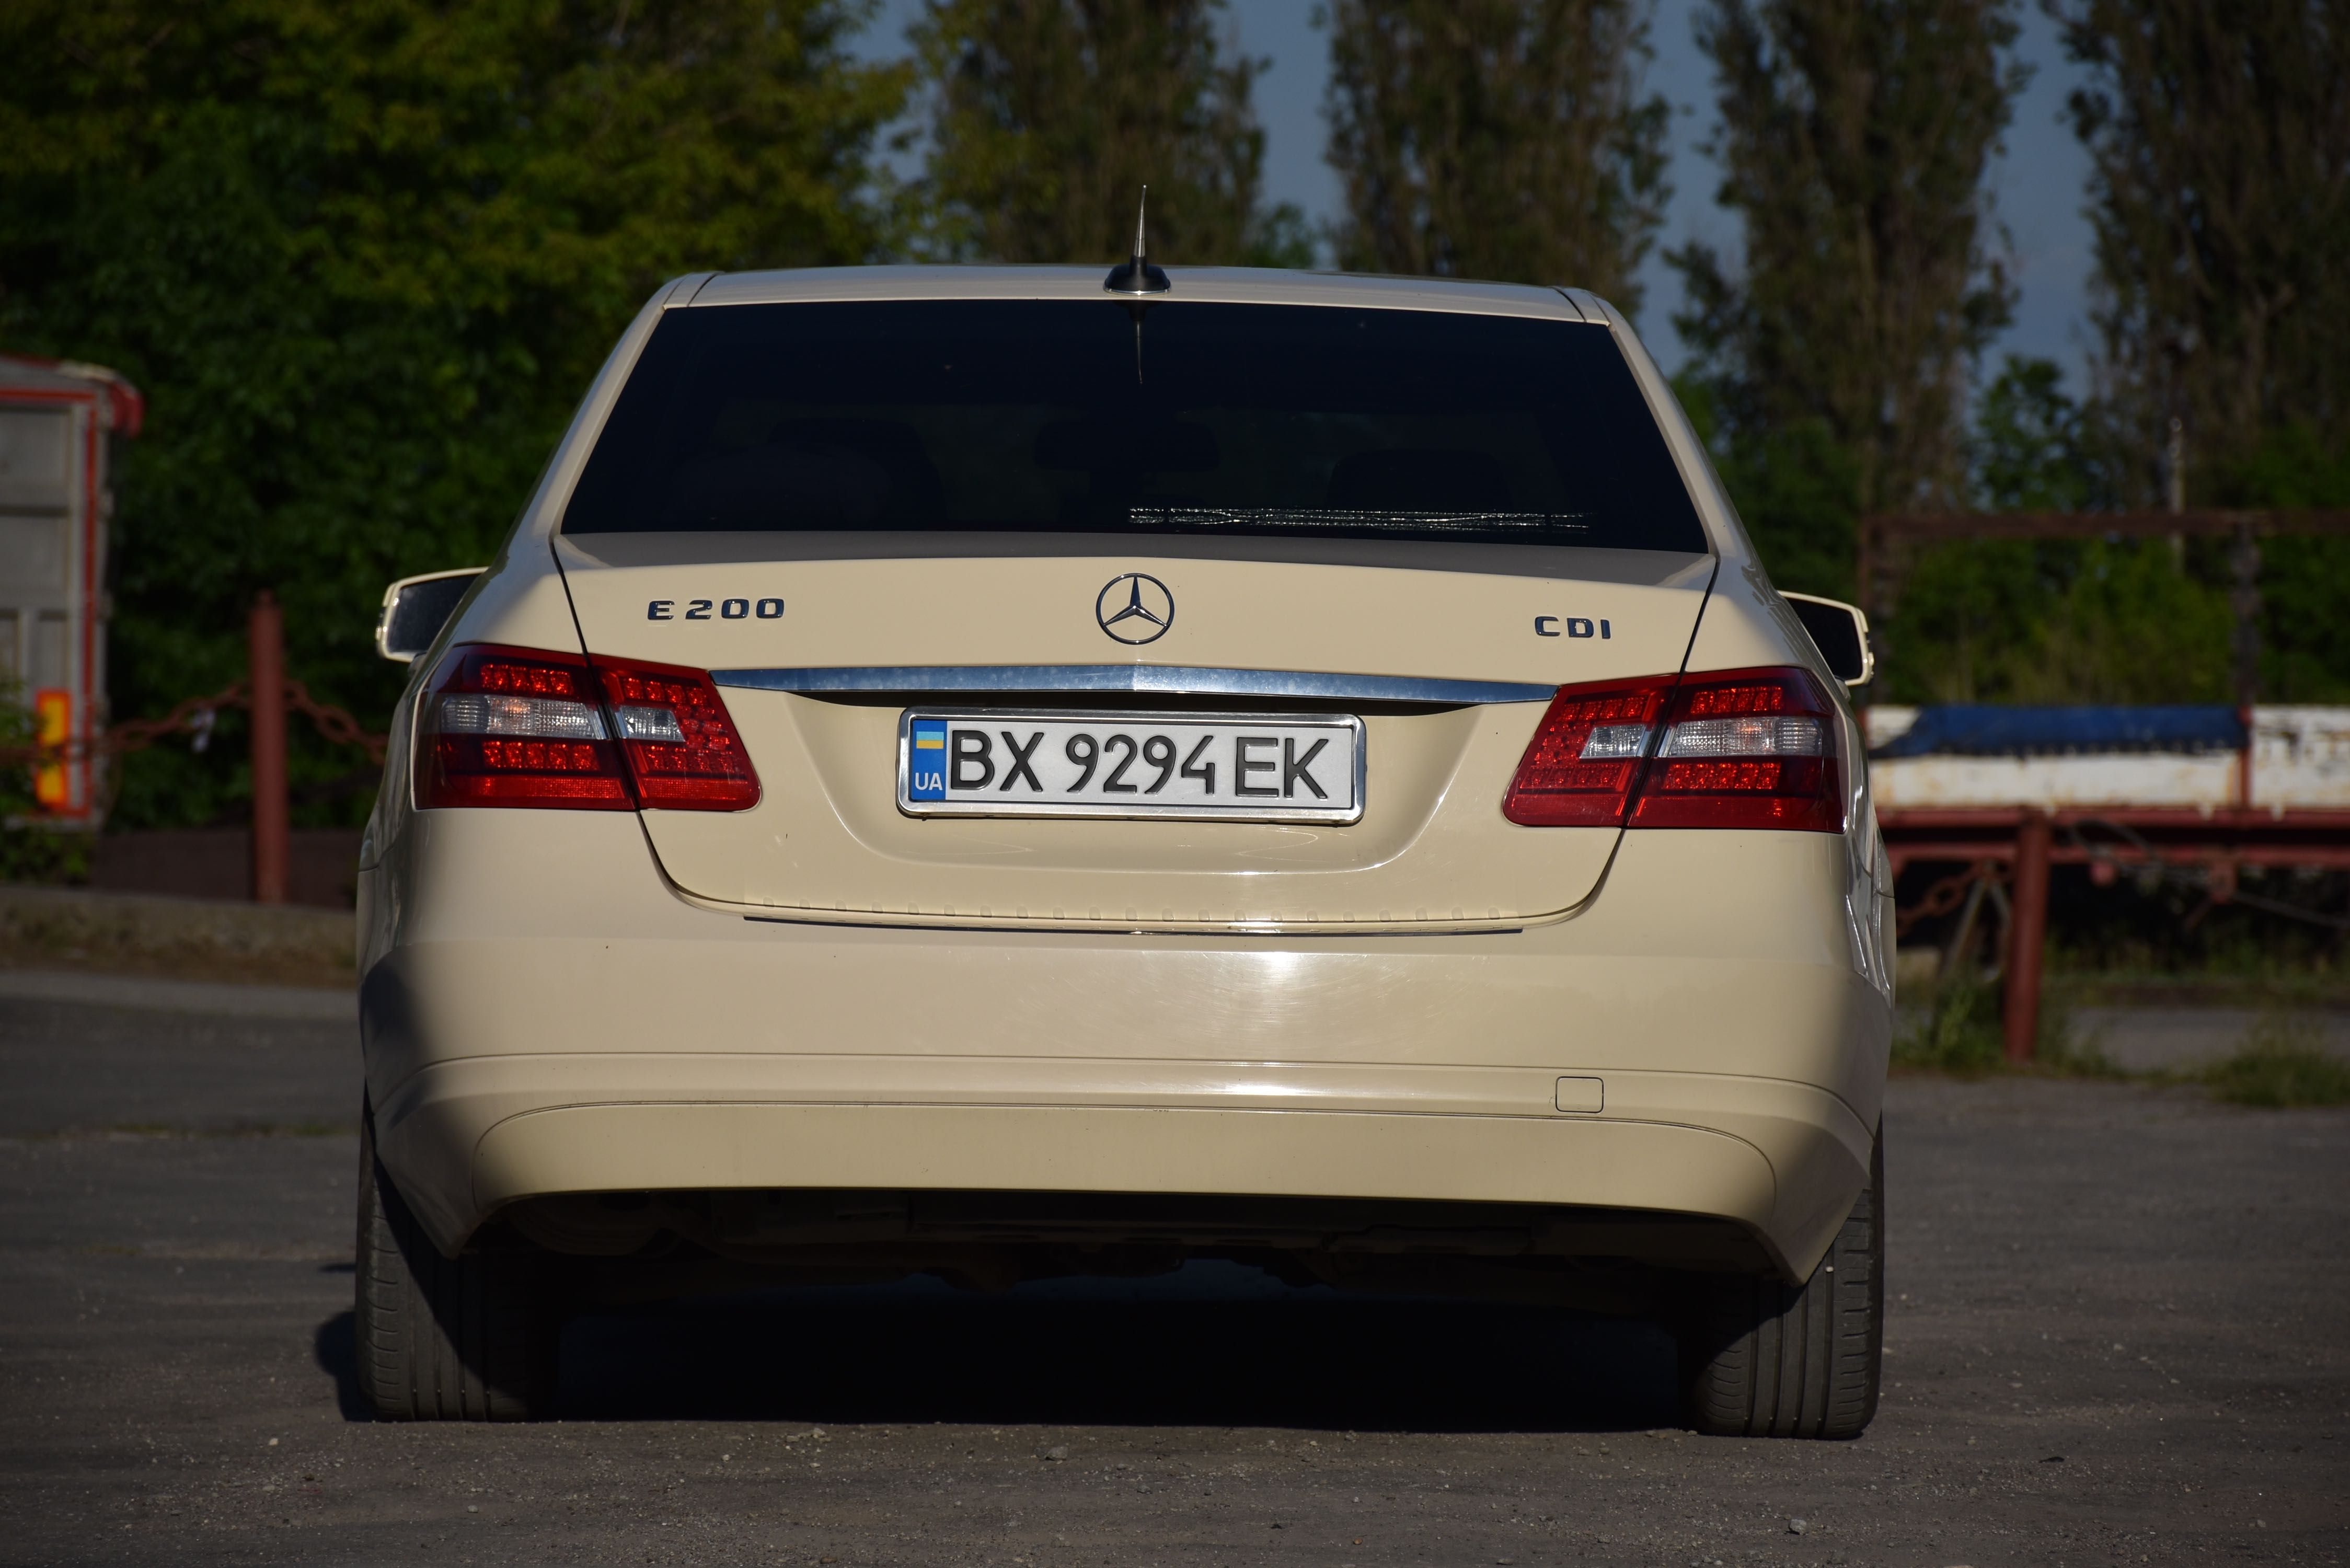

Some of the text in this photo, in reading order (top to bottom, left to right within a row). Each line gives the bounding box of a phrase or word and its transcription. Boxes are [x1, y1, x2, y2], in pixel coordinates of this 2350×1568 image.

[1534, 616, 1611, 640] CDI
[950, 729, 1330, 799] BX 9294 EK
[914, 771, 943, 791] UA
